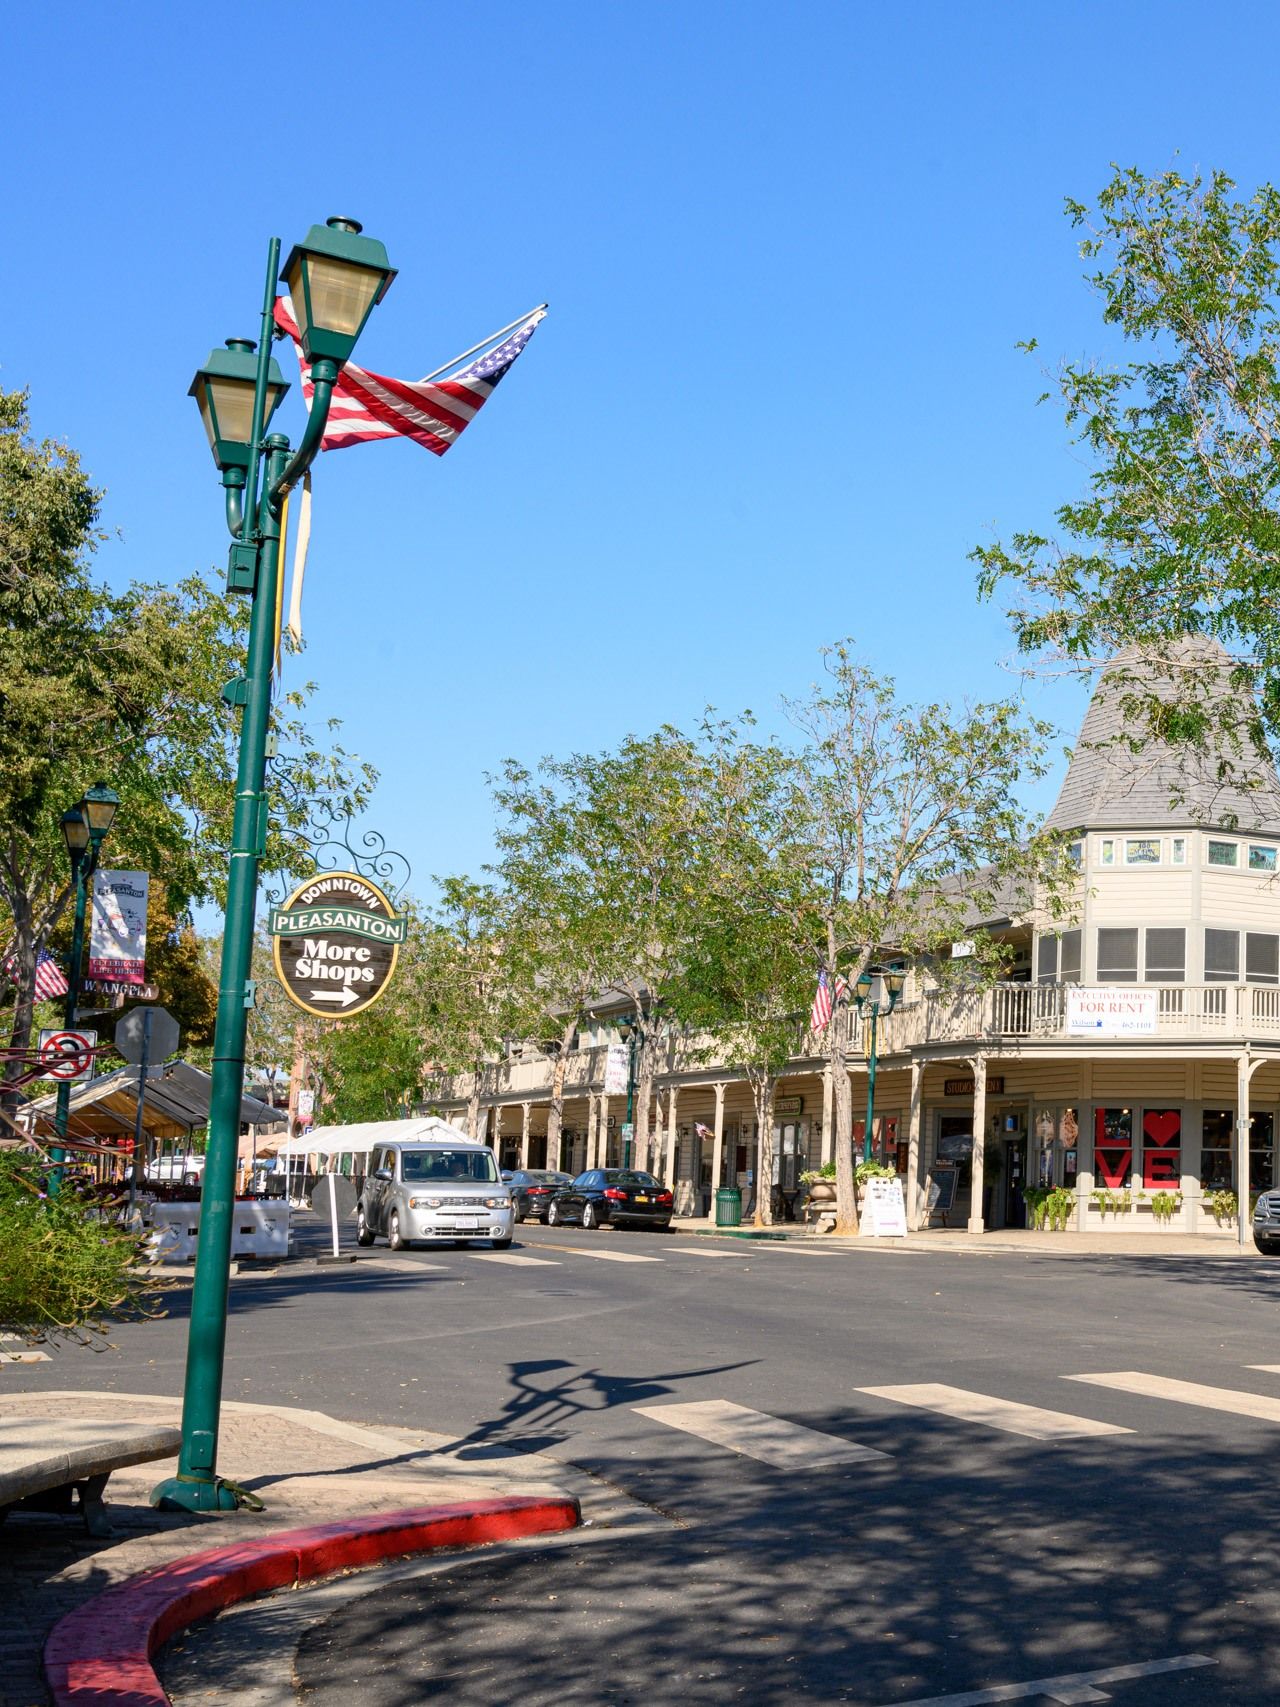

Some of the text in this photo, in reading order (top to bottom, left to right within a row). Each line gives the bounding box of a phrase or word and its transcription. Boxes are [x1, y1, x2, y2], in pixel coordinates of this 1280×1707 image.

[301, 879, 380, 909] DOWNTOWN
[277, 912, 400, 938] PLEASANTON
[302, 939, 371, 962] More
[92, 960, 142, 968] CELEBRATE
[93, 967, 113, 975] LIFE
[295, 958, 375, 986] Shops
[84, 980, 152, 998] W. ANGELA
[1072, 992, 1153, 1001] EXECUTIVE OFFICES
[1080, 1002, 1145, 1014] FOR RENT
